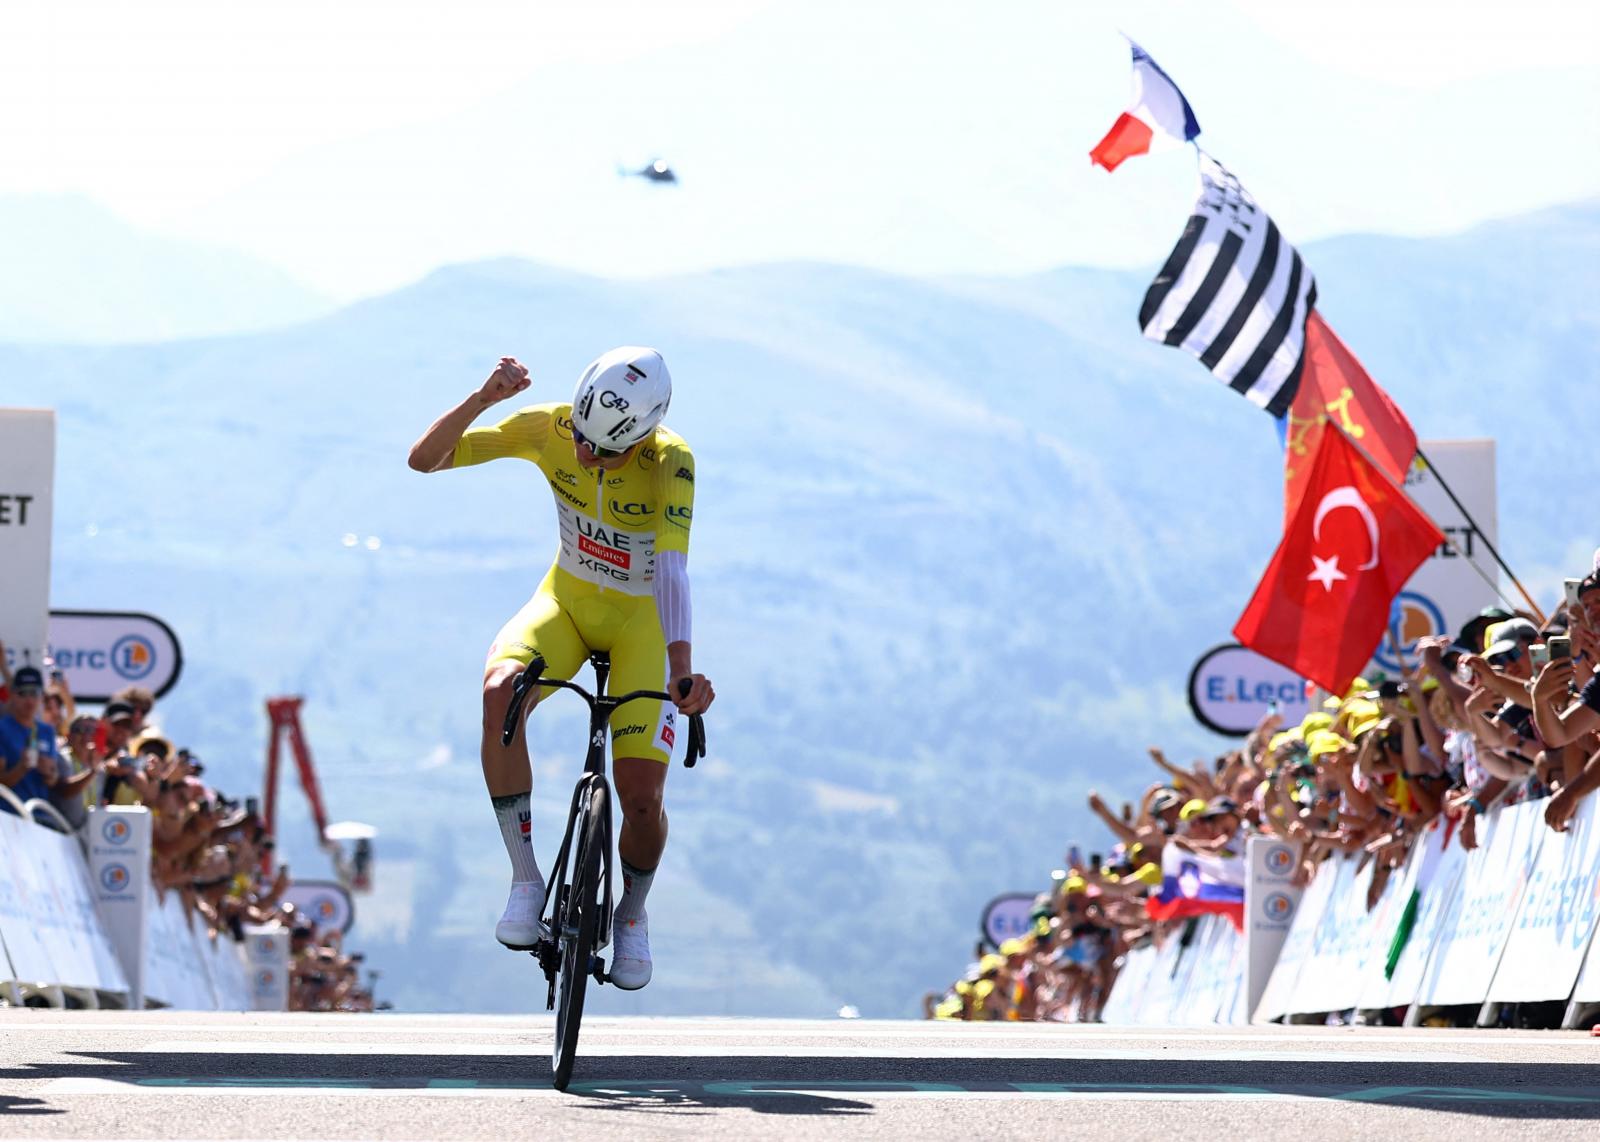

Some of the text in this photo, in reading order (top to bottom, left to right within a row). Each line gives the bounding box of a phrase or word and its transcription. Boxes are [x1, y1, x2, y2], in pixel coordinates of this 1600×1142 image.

[600, 390, 630, 414] G42
[612, 499, 656, 516] LCL
[668, 504, 693, 520] LC
[575, 515, 632, 552] UAE
[582, 539, 626, 565] Emirates
[577, 553, 631, 583] XRG
[1206, 676, 1307, 704] E.Lecl
